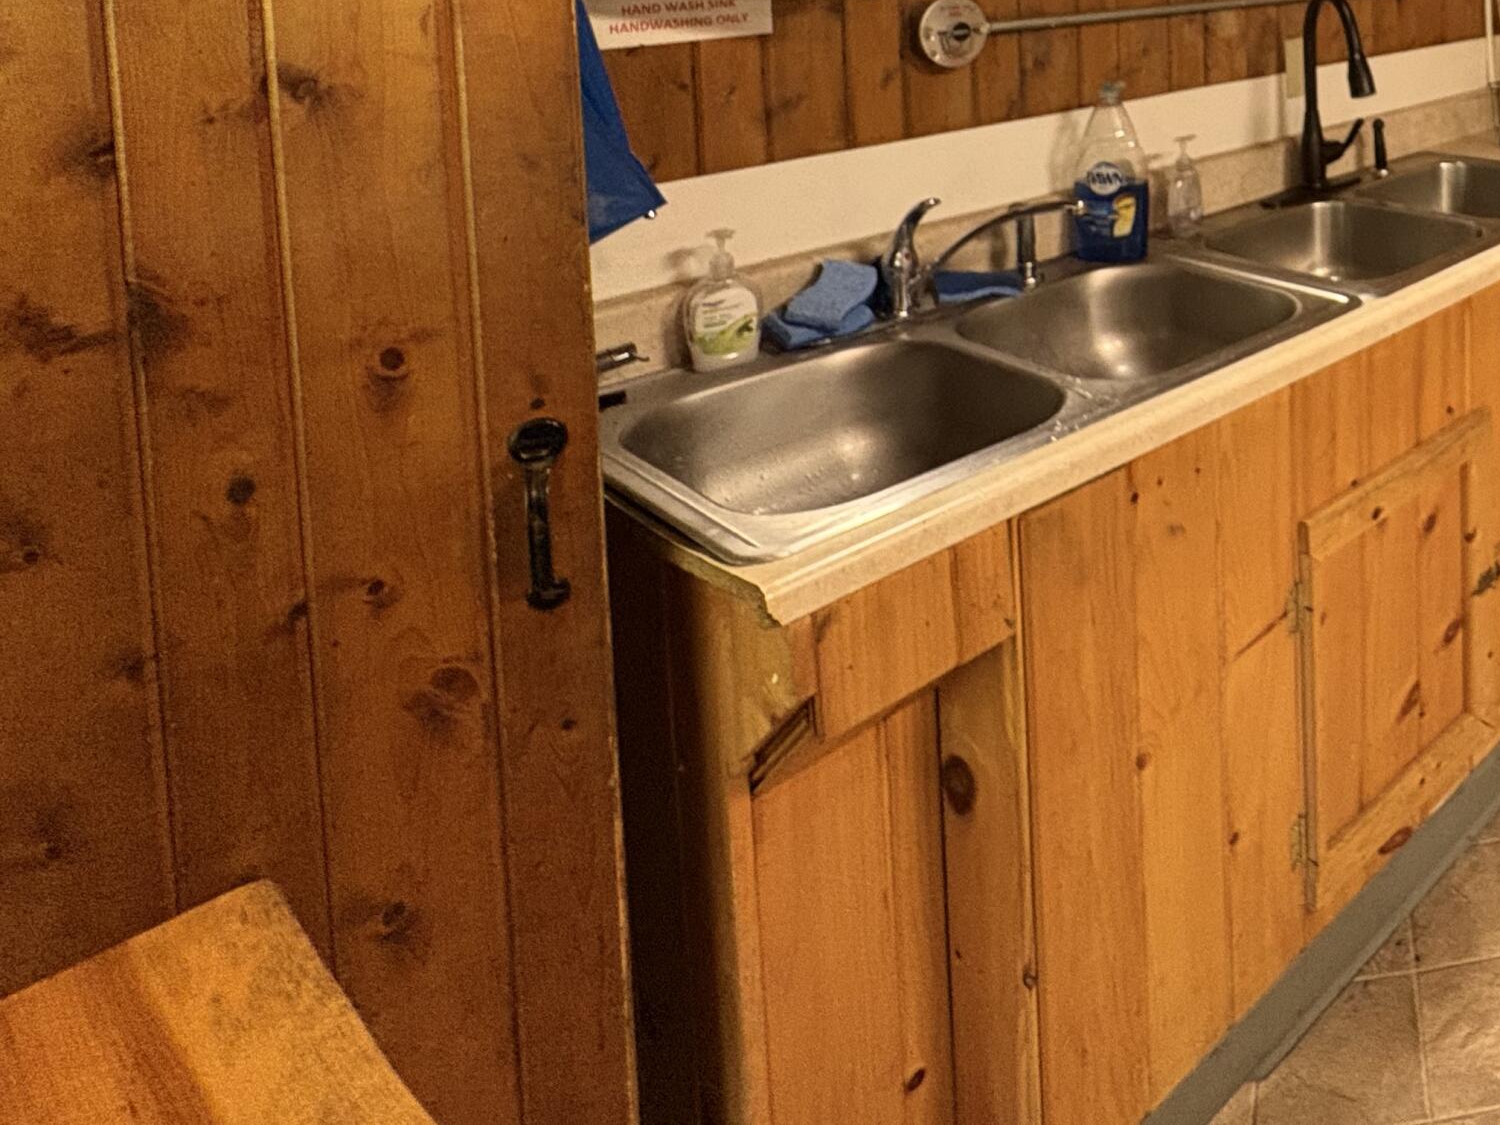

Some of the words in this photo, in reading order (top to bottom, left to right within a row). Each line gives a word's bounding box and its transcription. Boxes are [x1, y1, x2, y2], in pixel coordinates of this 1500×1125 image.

[621, 2, 661, 16] HAND
[664, 0, 705, 13] WASH
[609, 15, 713, 35] HANDWASHING
[715, 12, 749, 26] ONLY
